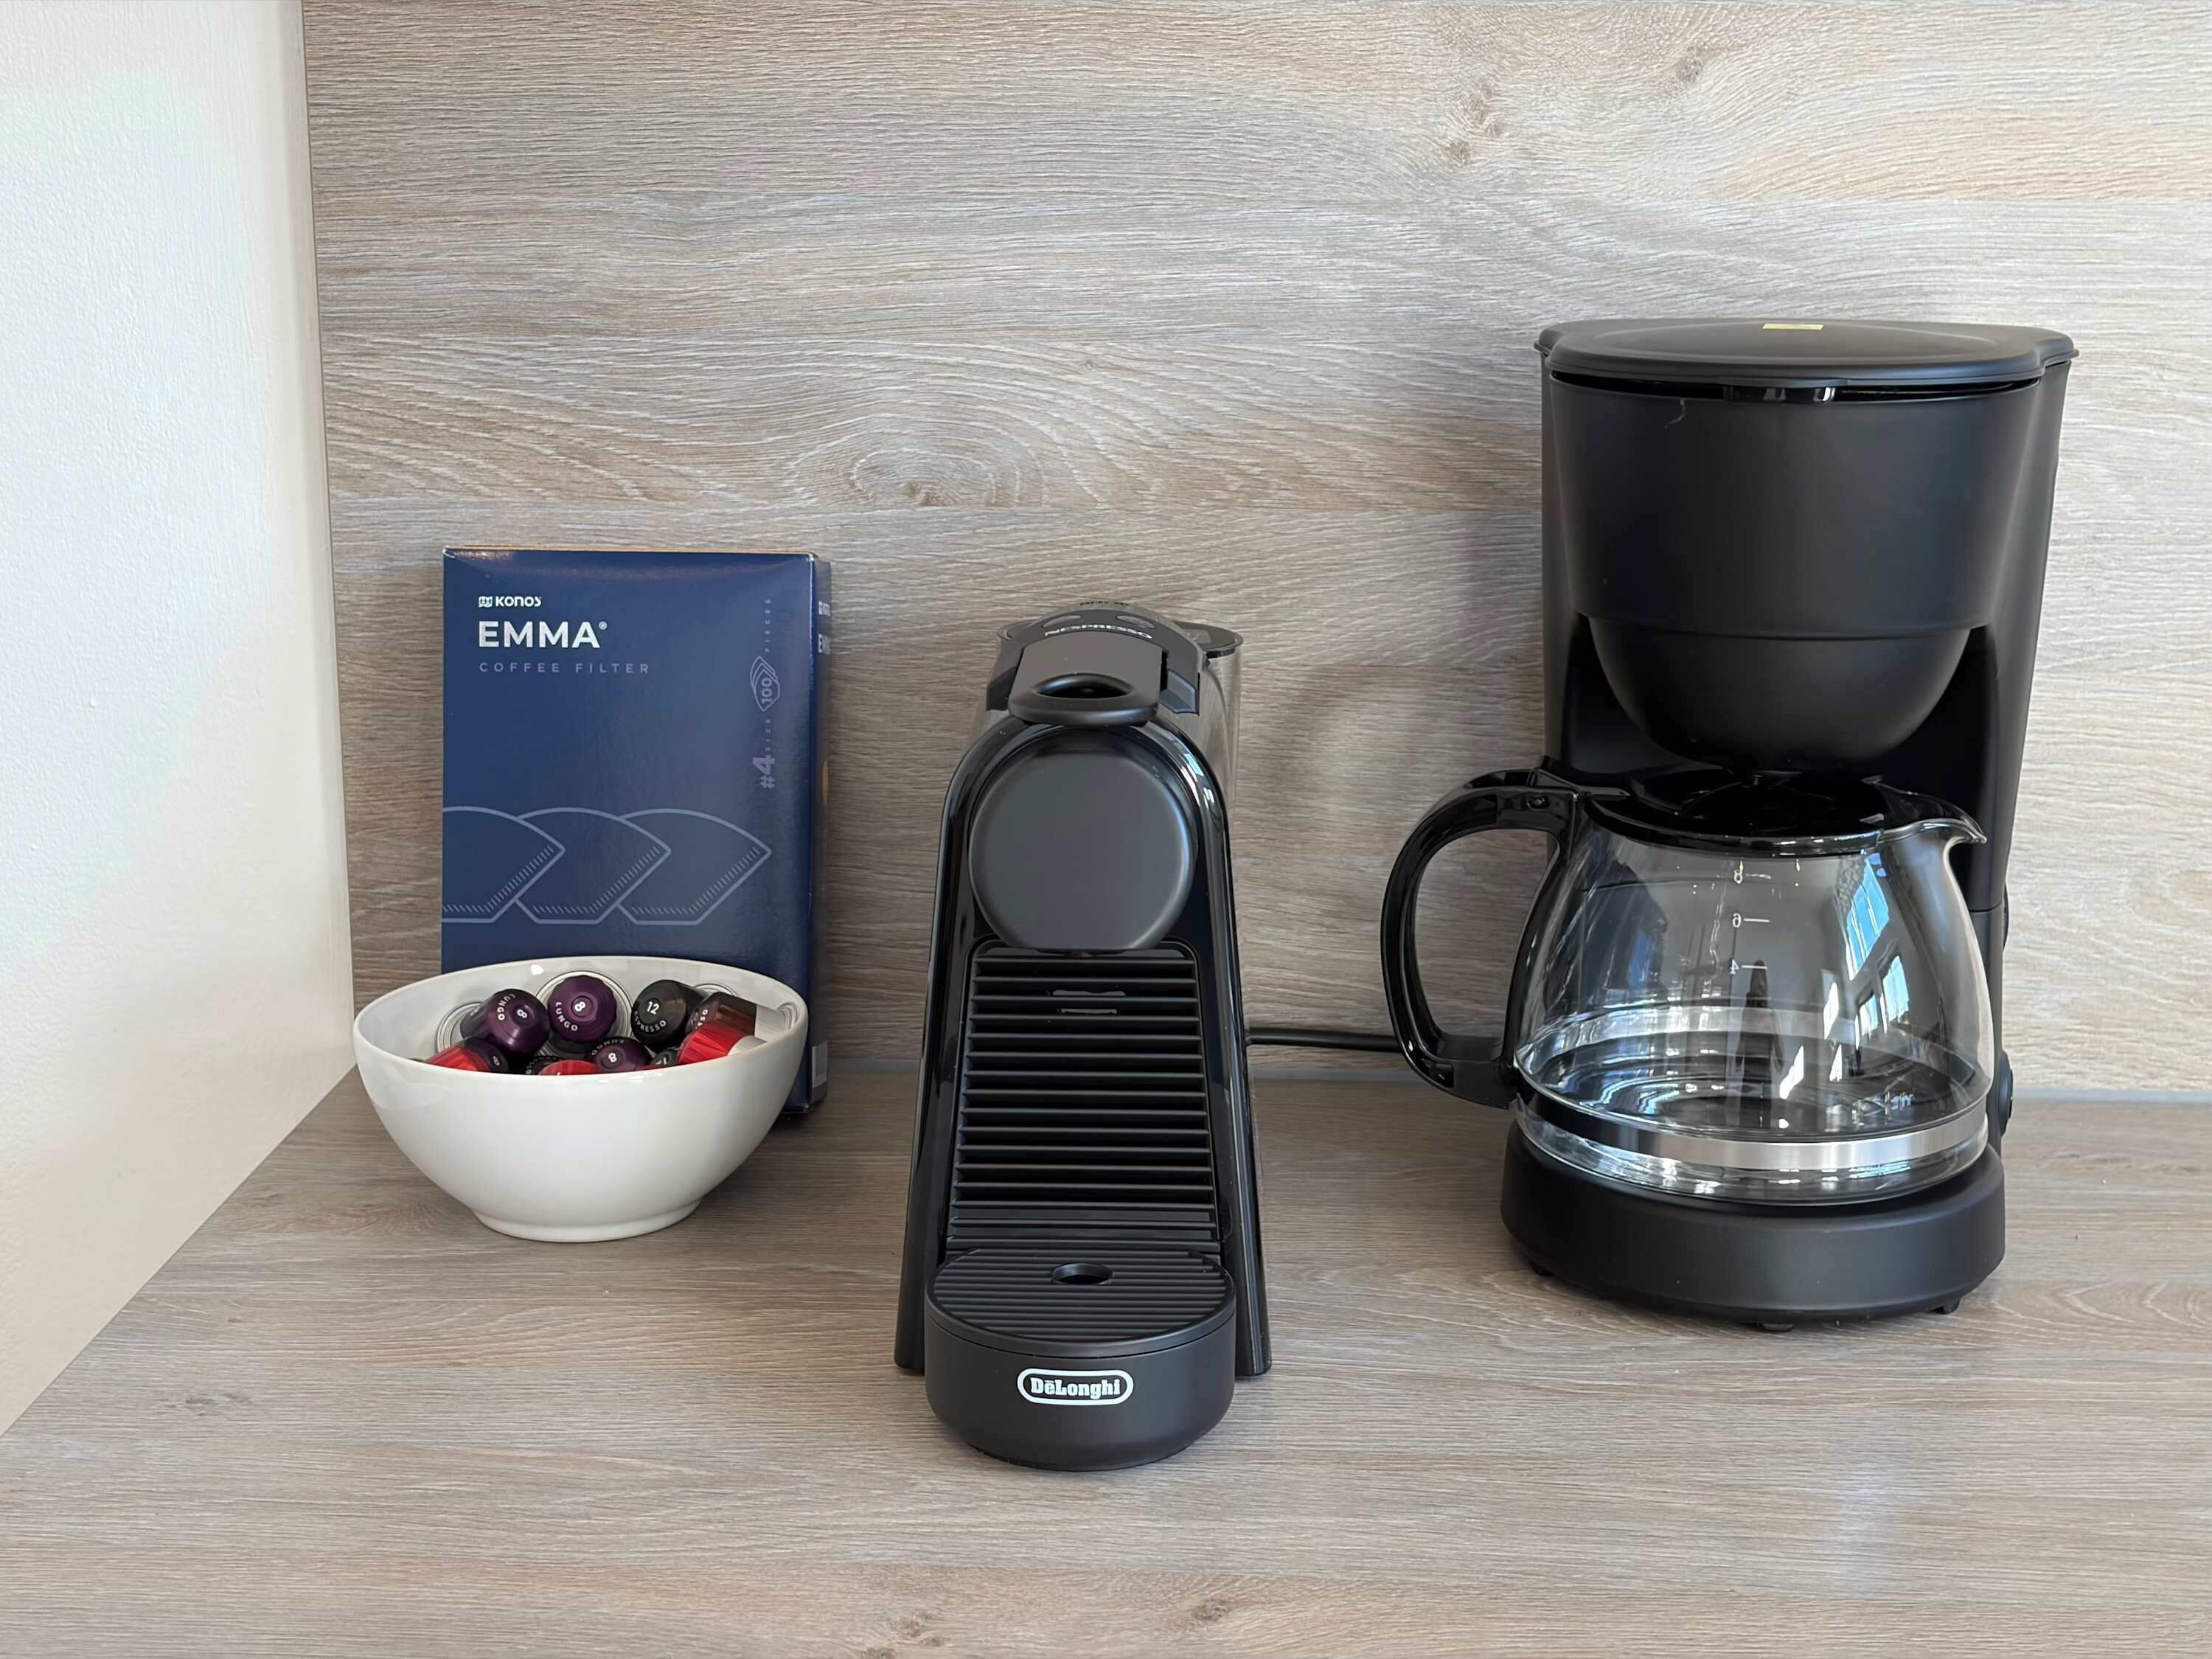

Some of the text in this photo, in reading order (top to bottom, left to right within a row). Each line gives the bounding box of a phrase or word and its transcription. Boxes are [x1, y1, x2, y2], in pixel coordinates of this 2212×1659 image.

[479, 661, 649, 674] COFFEE FILTER
[761, 677, 773, 704] 100
[496, 993, 516, 1022] LUNGO
[574, 1001, 586, 1012] 8
[646, 1001, 661, 1015] 12
[516, 1008, 528, 1019] 8
[555, 1001, 579, 1032] LUNGO
[608, 1052, 618, 1063] 8
